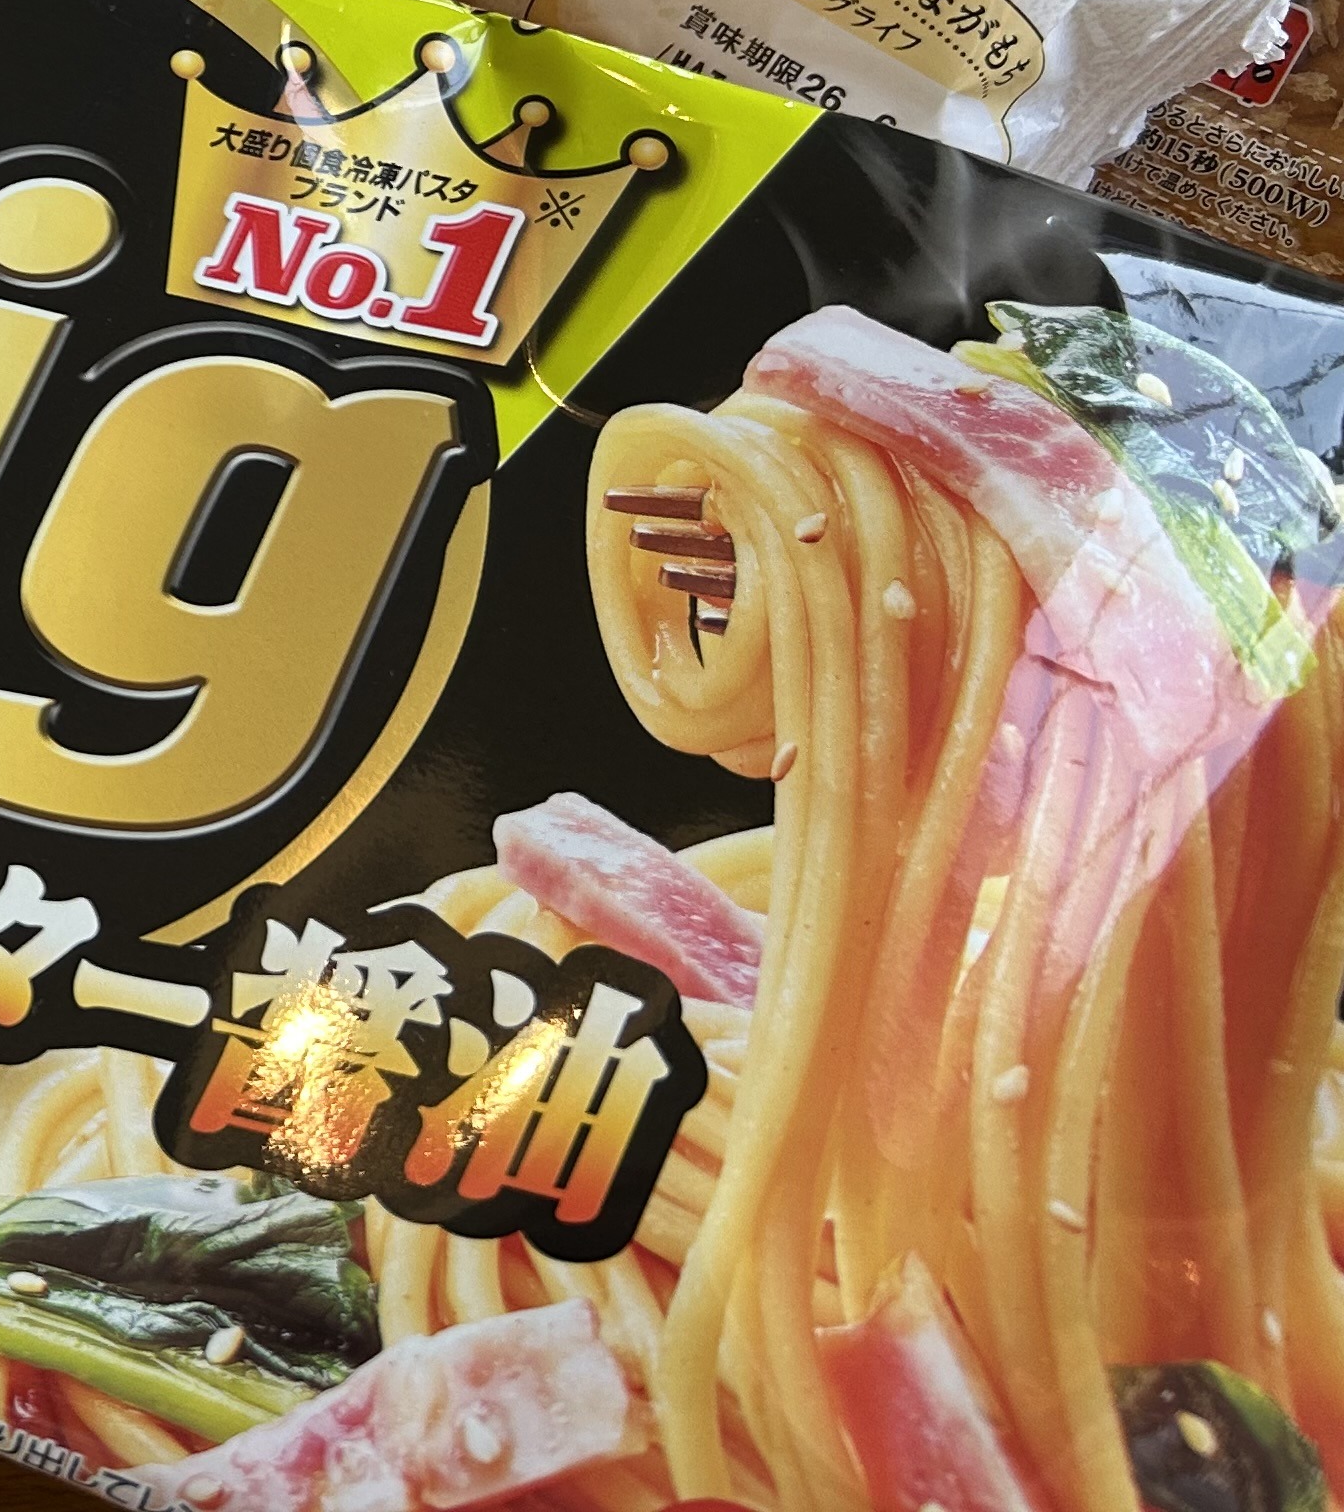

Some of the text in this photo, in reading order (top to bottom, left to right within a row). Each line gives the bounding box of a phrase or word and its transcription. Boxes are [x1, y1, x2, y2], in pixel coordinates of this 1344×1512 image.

[678, 3, 849, 112] 賞味期限26
[208, 122, 479, 205] 大盛り個食冷凍パスタ
[289, 173, 407, 223] ブランド
[201, 200, 518, 340] No.1
